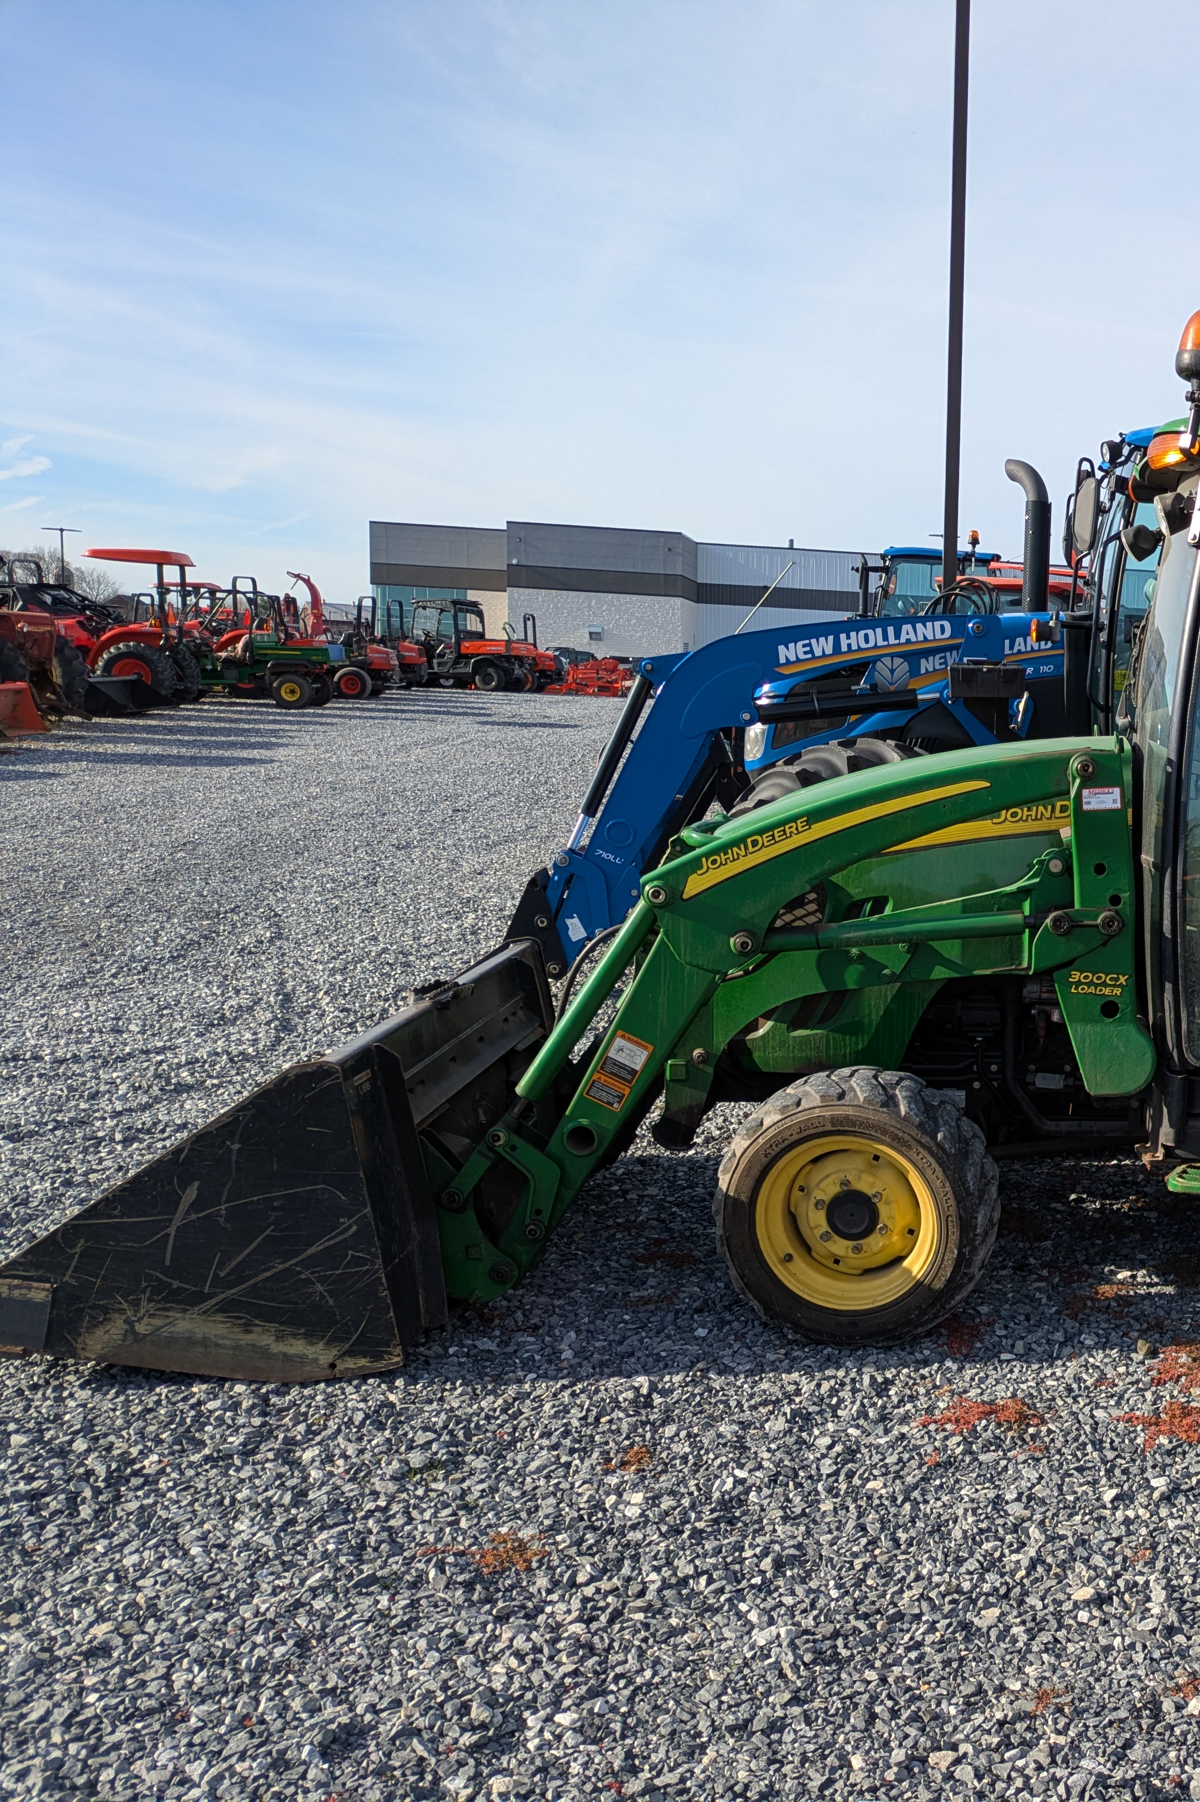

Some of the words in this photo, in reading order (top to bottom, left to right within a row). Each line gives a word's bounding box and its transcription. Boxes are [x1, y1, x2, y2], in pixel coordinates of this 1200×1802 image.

[777, 635, 834, 664] NEW
[839, 620, 952, 652] HOLLAND
[920, 650, 958, 674] NEW
[1039, 665, 1054, 673] 110
[992, 804, 1052, 824] JOHN
[696, 843, 746, 875] JOHN
[746, 816, 810, 853] DEERE
[1068, 970, 1130, 986] 300CX
[1070, 984, 1122, 996] LOADER
[626, 1035, 649, 1050] WARNING
[603, 1078, 626, 1093] WARNING
